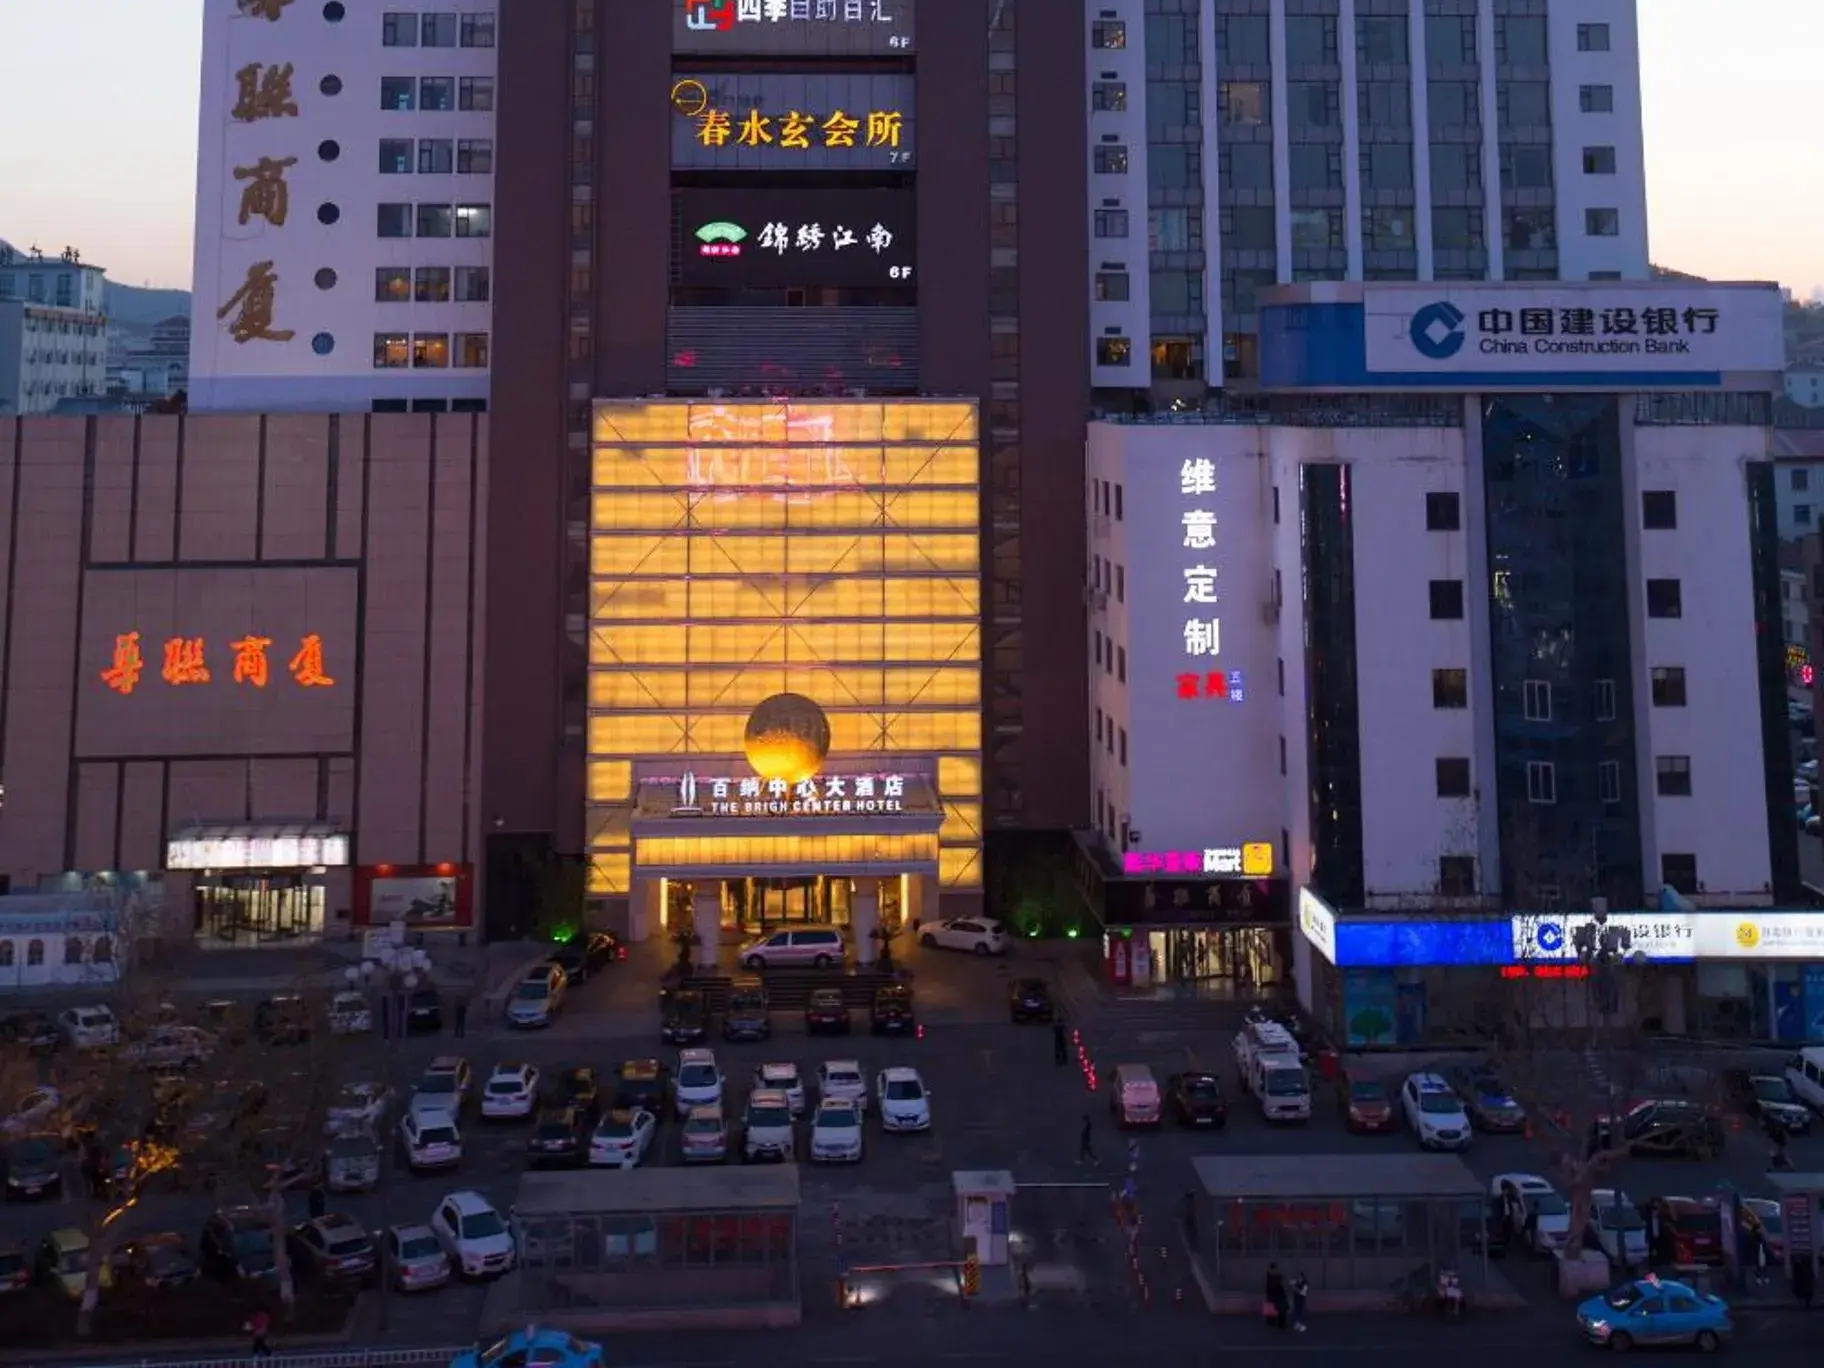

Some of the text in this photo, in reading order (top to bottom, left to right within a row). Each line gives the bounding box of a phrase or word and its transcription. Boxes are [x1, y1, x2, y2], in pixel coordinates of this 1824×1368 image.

[697, 109, 902, 149] 春水玄会所
[889, 266, 912, 279] 6F
[1479, 305, 1719, 335] 中国建设银行
[1480, 338, 1690, 354] China Construction Bank
[1180, 457, 1220, 655] 维意定制
[710, 775, 905, 799] 百纳中心大酒店
[711, 801, 739, 814] THE
[793, 799, 852, 813] CENTER
[856, 799, 903, 812] HOTEL
